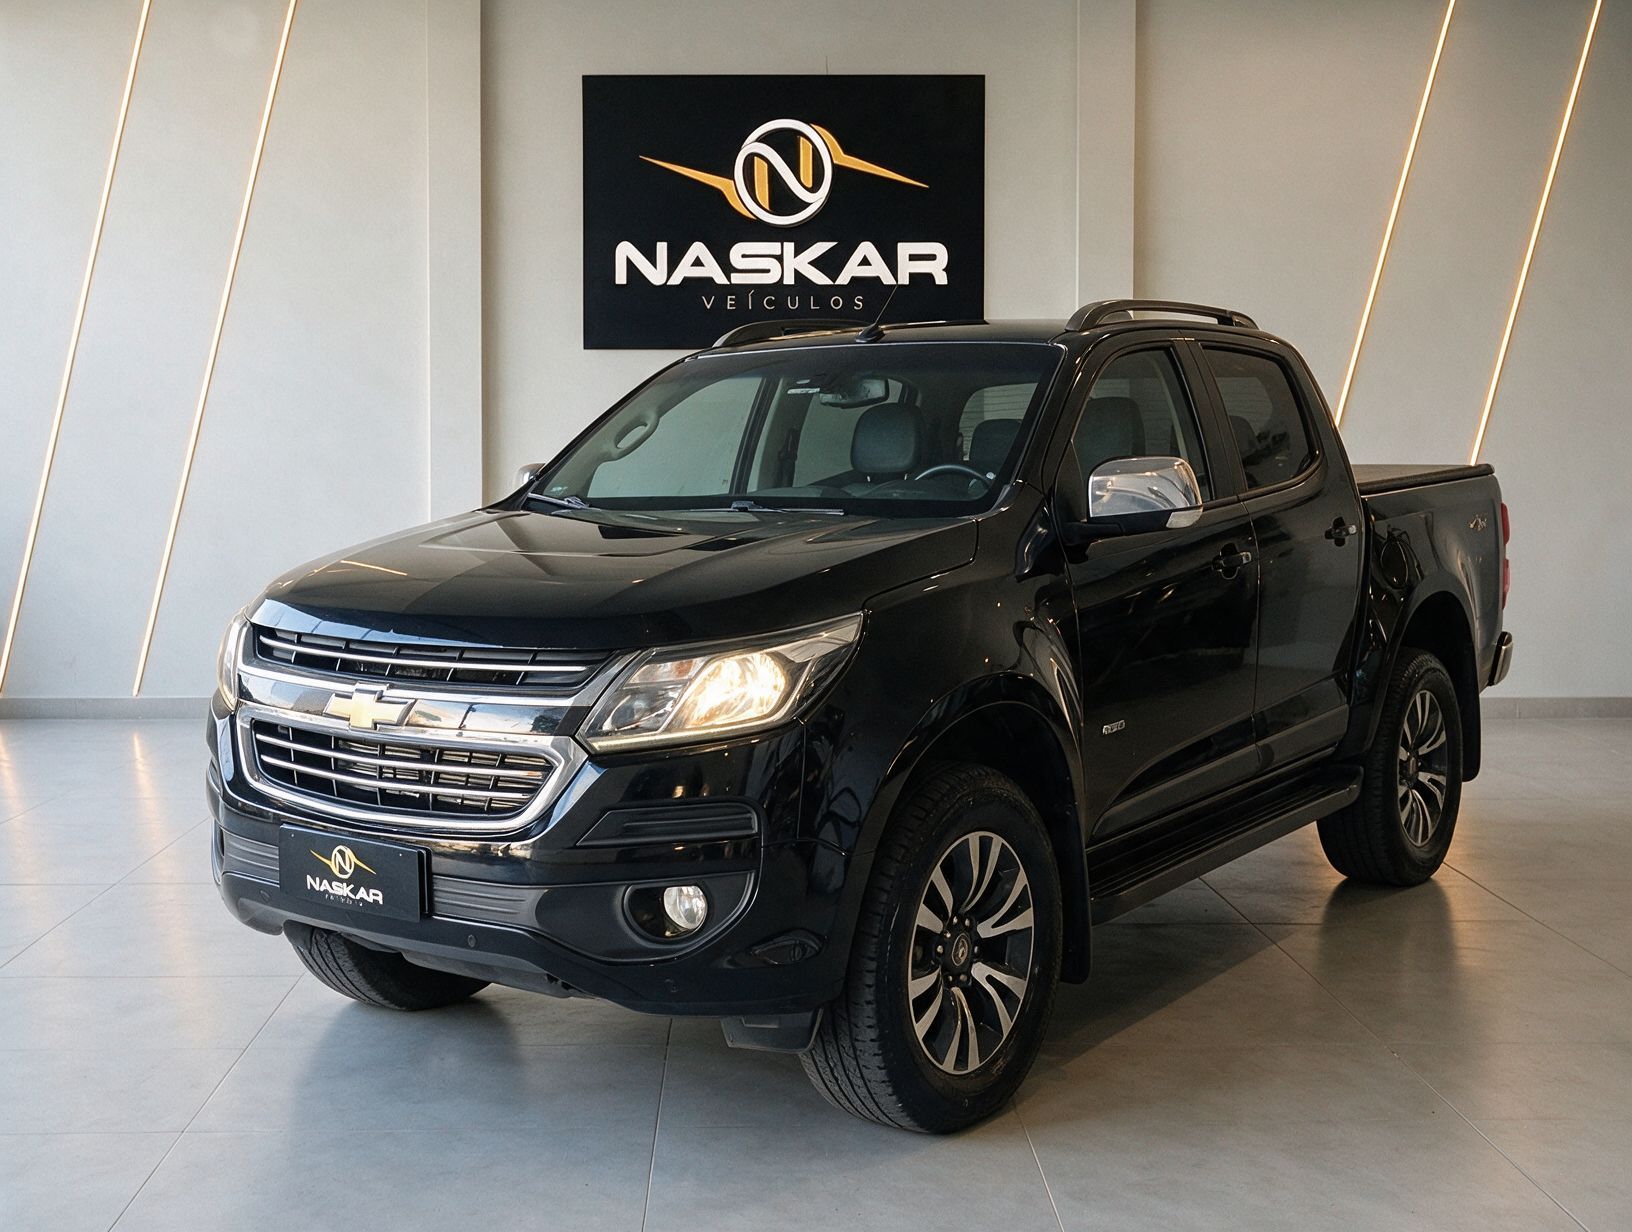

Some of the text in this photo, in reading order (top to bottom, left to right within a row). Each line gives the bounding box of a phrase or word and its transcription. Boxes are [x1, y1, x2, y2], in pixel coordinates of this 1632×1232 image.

[614, 241, 949, 285] NASKAR
[701, 289, 864, 311] VEÍCULOS
[306, 875, 383, 905] NASKAR
